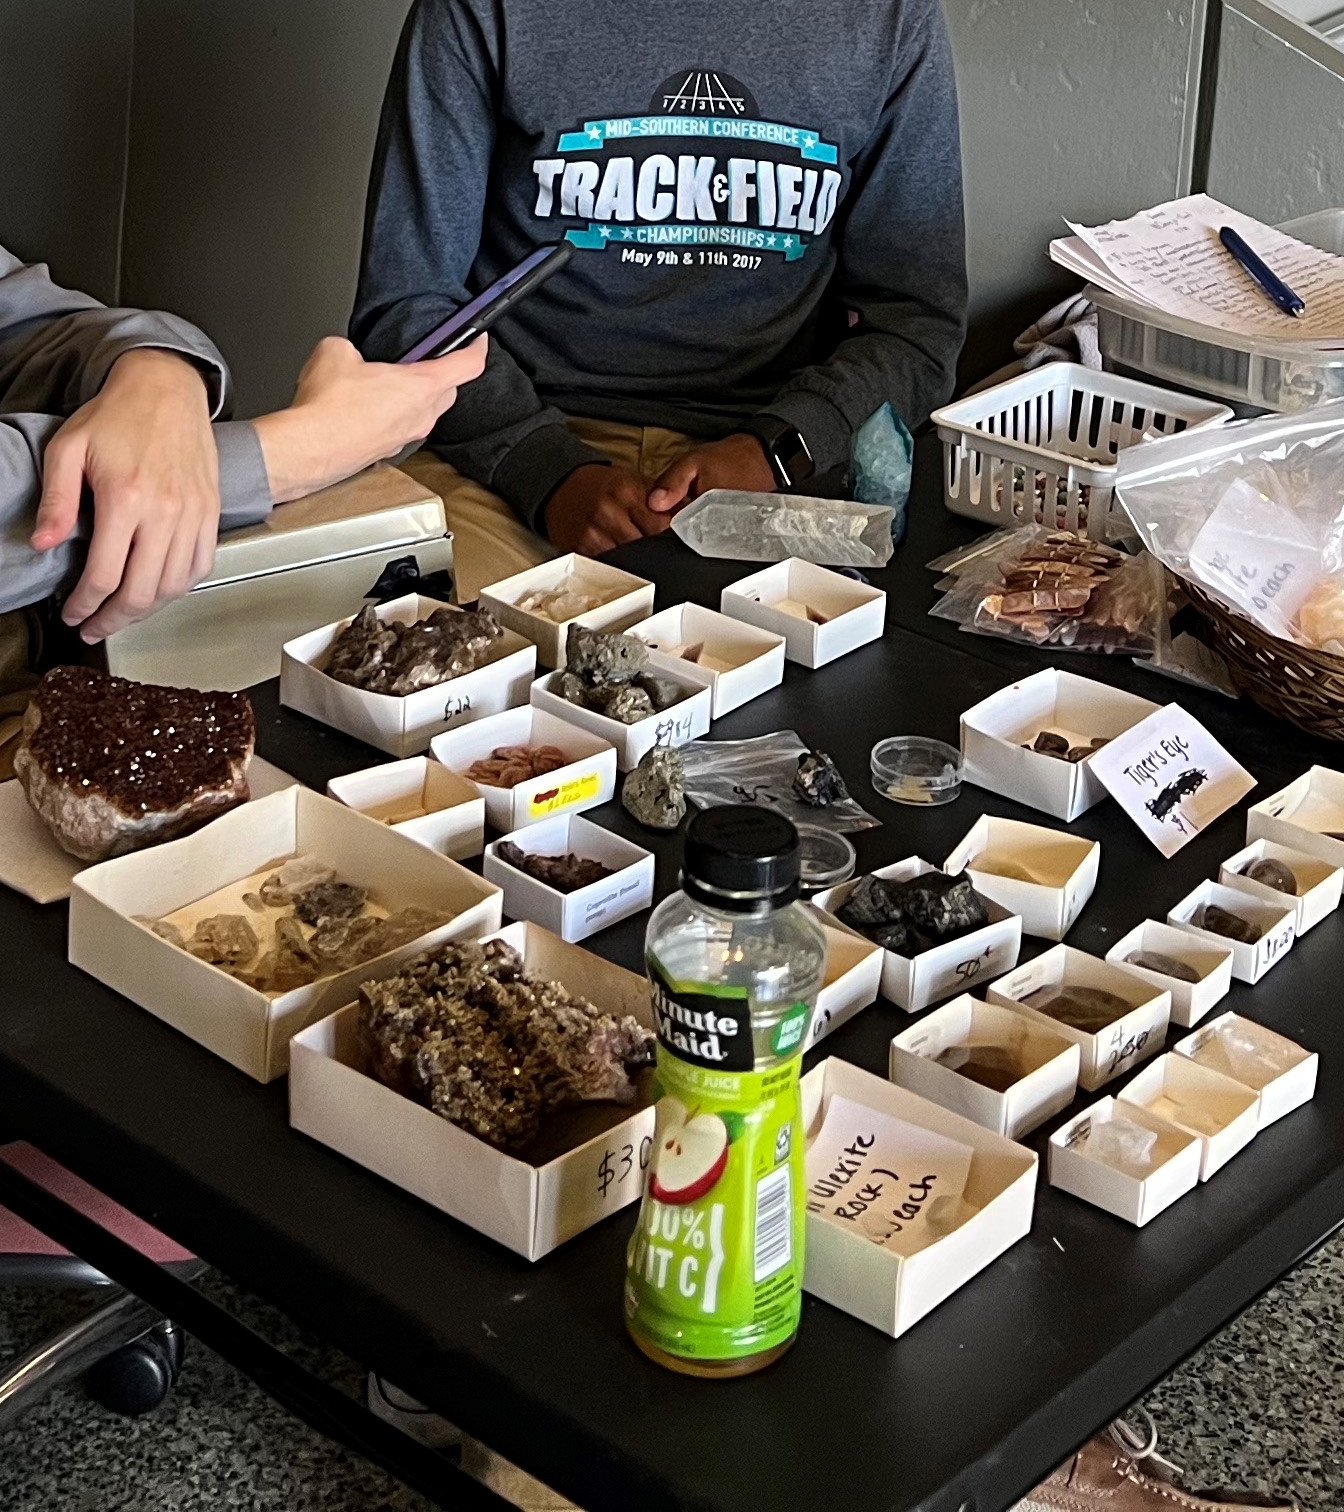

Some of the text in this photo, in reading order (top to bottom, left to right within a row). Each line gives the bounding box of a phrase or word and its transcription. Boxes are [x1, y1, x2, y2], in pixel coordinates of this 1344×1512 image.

[662, 98, 669, 108] 1
[680, 99, 687, 110] 2
[699, 100, 706, 110] 3
[718, 101, 725, 110] 4
[606, 120, 799, 144] MID-SOUTHERN CONFERENCE
[533, 154, 842, 235] TRACK & FIELD
[621, 248, 762, 270] May 9th & 11th 2017
[636, 226, 764, 248] CHAMPIONSHIPS
[1123, 735, 1189, 787] Tiger's Eye
[655, 1006, 723, 1062] Maid
[702, 1076, 740, 1091] JUICE
[597, 1135, 653, 1198] $30
[893, 1174, 937, 1221] each
[646, 1198, 706, 1255] 00%
[679, 1255, 699, 1298] C
